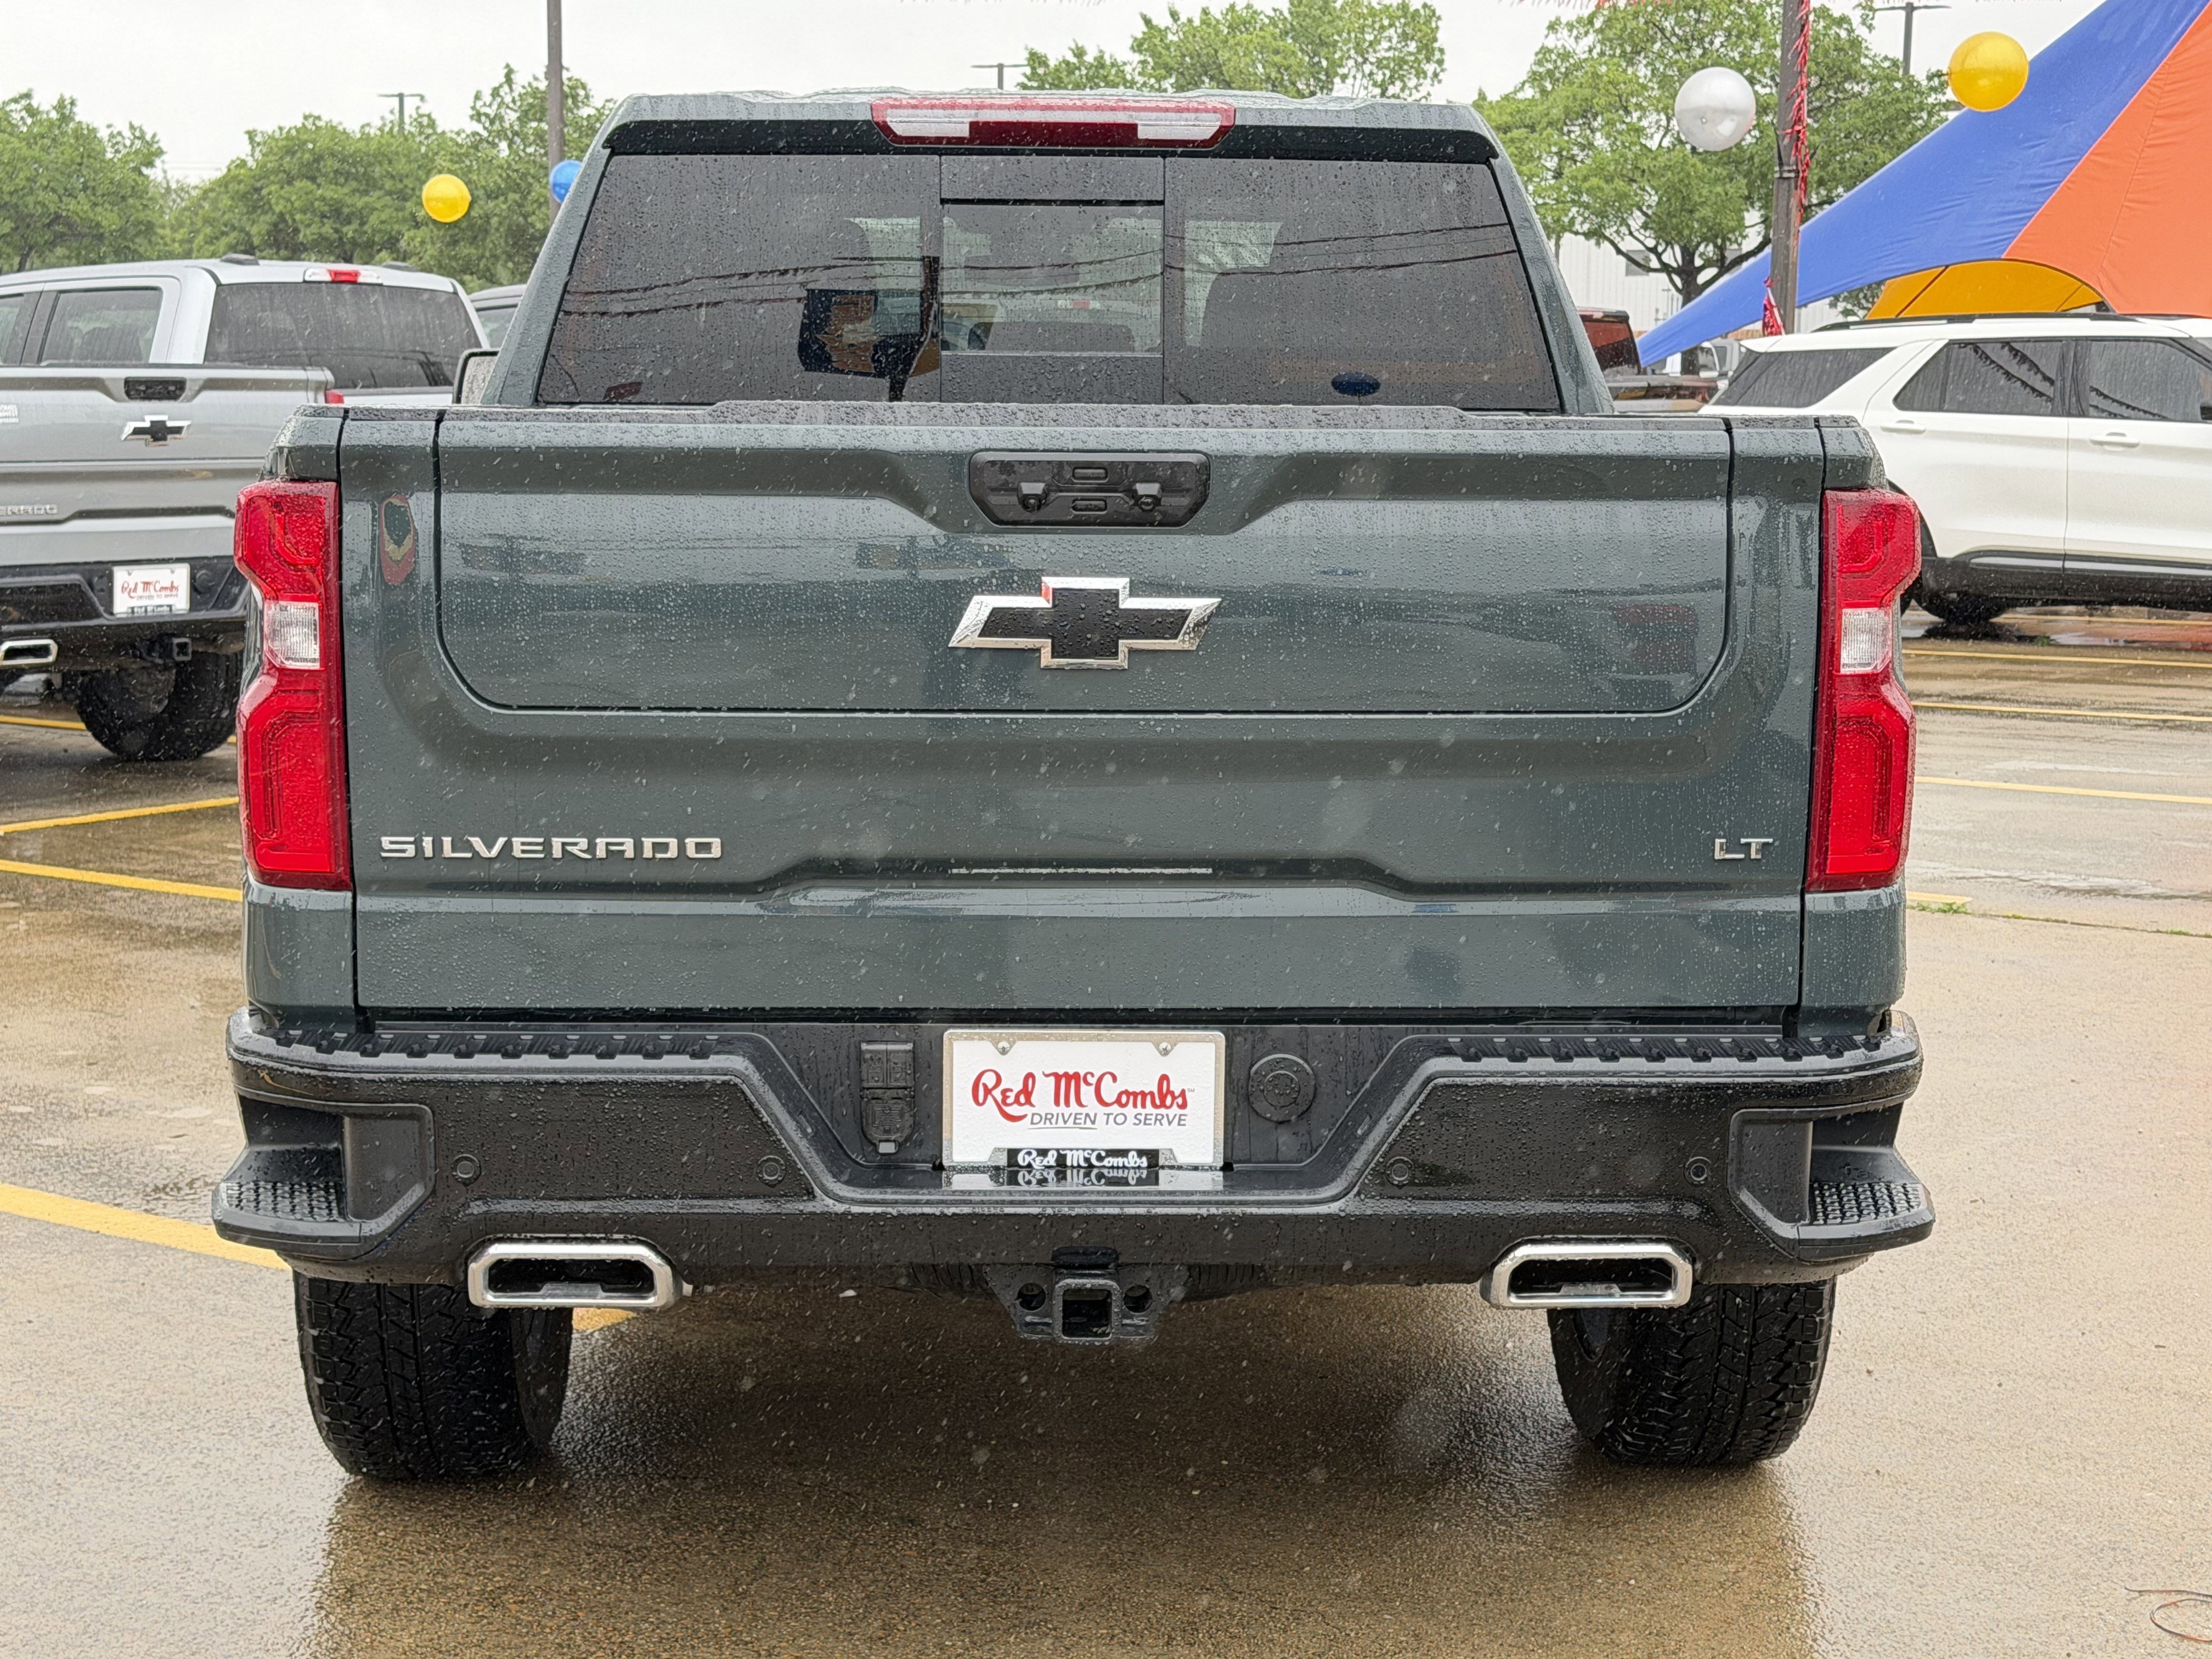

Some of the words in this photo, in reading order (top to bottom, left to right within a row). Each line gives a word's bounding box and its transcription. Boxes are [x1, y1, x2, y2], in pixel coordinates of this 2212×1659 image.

[380, 837, 721, 859] SILVERADO
[1714, 838, 1774, 860] LT
[972, 1069, 1036, 1123] Red
[1042, 1070, 1188, 1110] McCombs
[1030, 1112, 1097, 1126] DRIVEN
[1103, 1112, 1127, 1126] TO
[1132, 1113, 1188, 1127] SERVE
[1017, 1149, 1058, 1170] Red
[1059, 1149, 1148, 1167] McCombs
